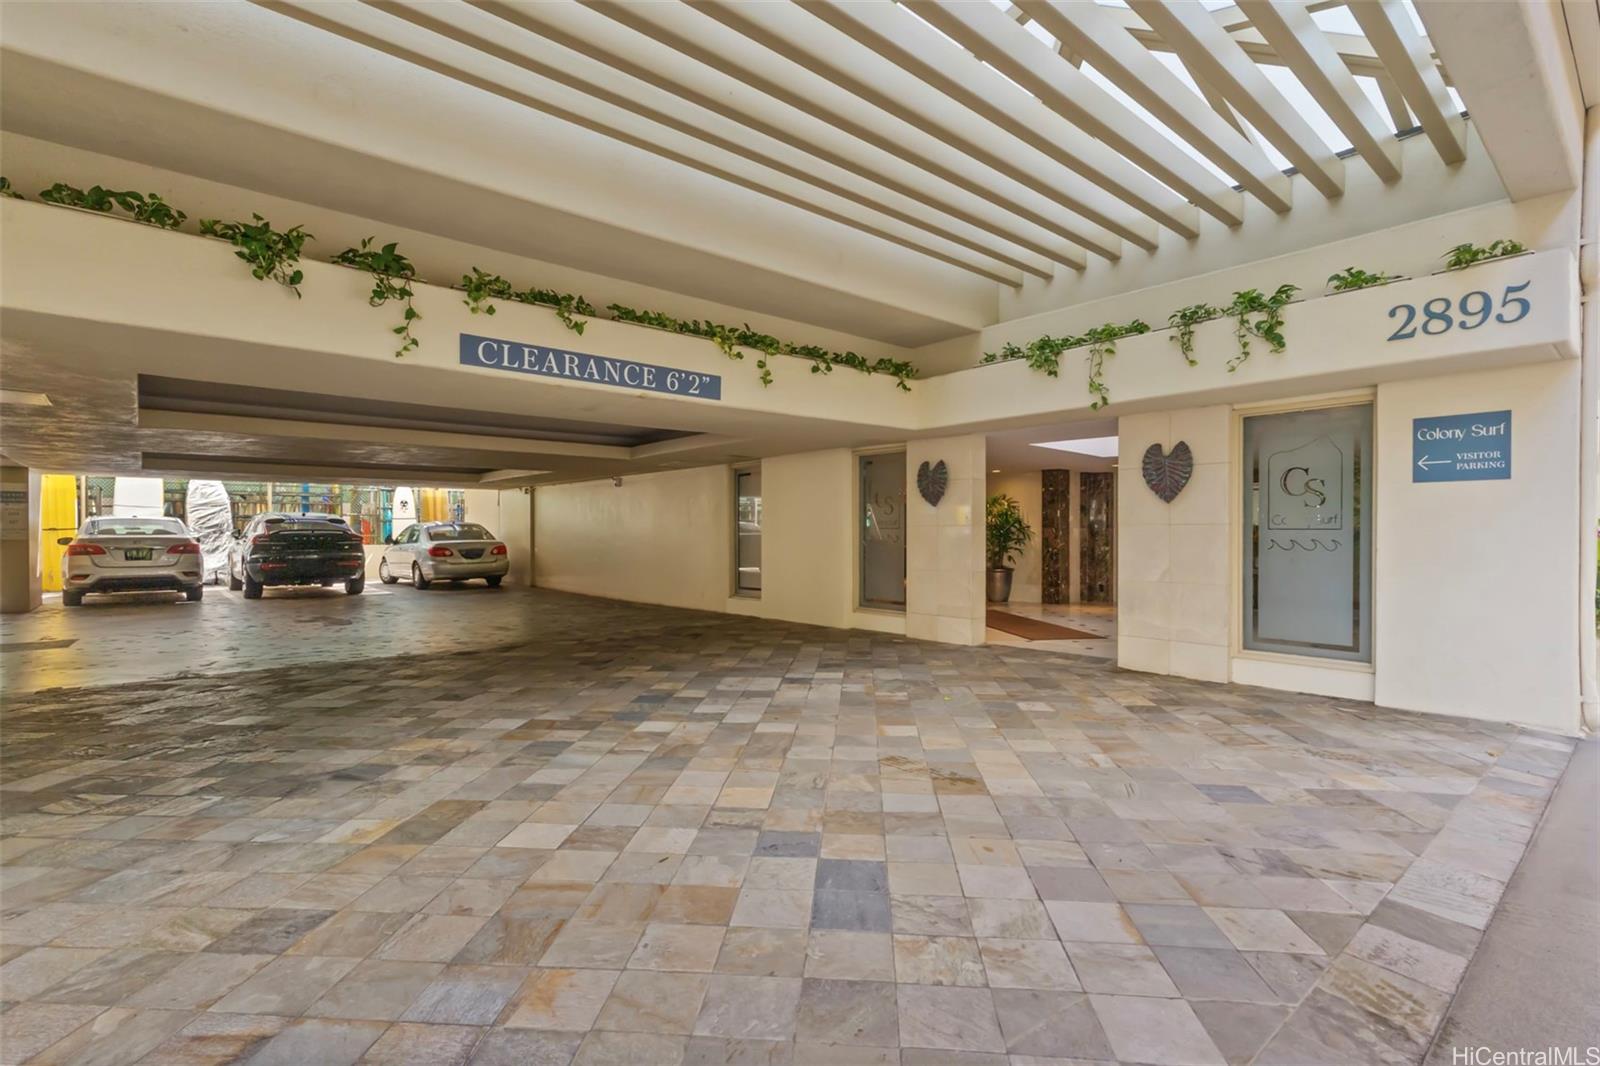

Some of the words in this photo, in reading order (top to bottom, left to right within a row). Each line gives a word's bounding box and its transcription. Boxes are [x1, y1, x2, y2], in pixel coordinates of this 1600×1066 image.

[1386, 279, 1531, 341] 2895
[477, 340, 656, 388] CLEARANCE
[1417, 427, 1466, 441] Colony
[1471, 422, 1506, 437] Surf
[1456, 451, 1501, 460] VISITOR
[1456, 461, 1505, 470] PARKING
